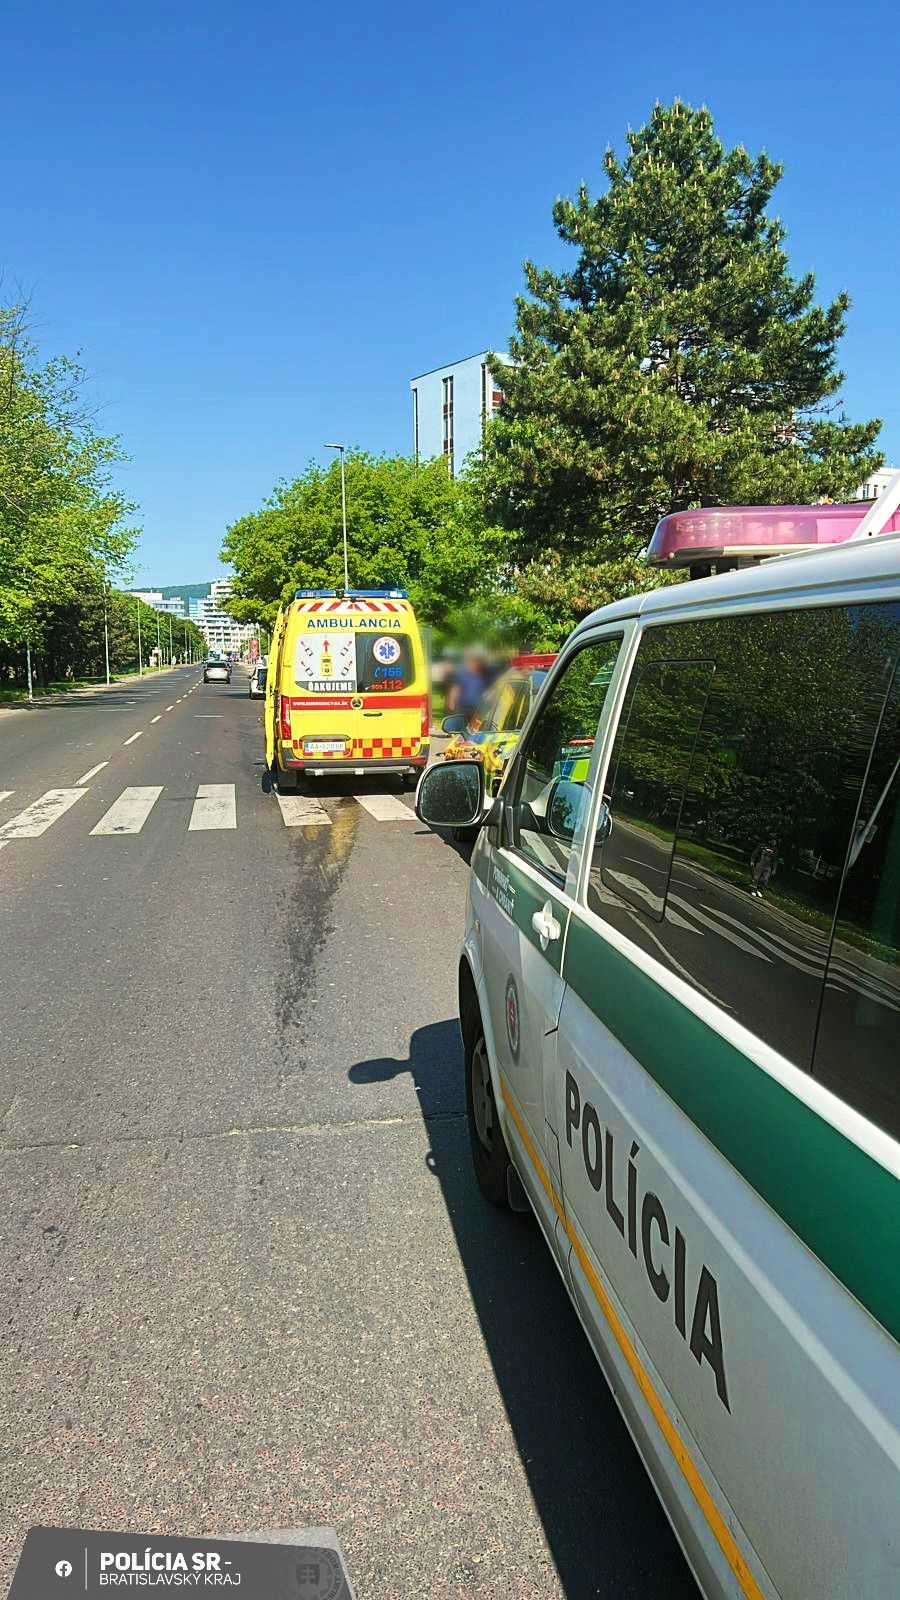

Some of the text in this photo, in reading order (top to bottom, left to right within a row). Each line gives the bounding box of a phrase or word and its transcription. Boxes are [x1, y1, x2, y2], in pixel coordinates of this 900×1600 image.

[307, 618, 401, 628] AMBULANCIA
[382, 667, 402, 677] 155
[382, 680, 403, 690] 112
[565, 1068, 732, 1416] POLÍCIA
